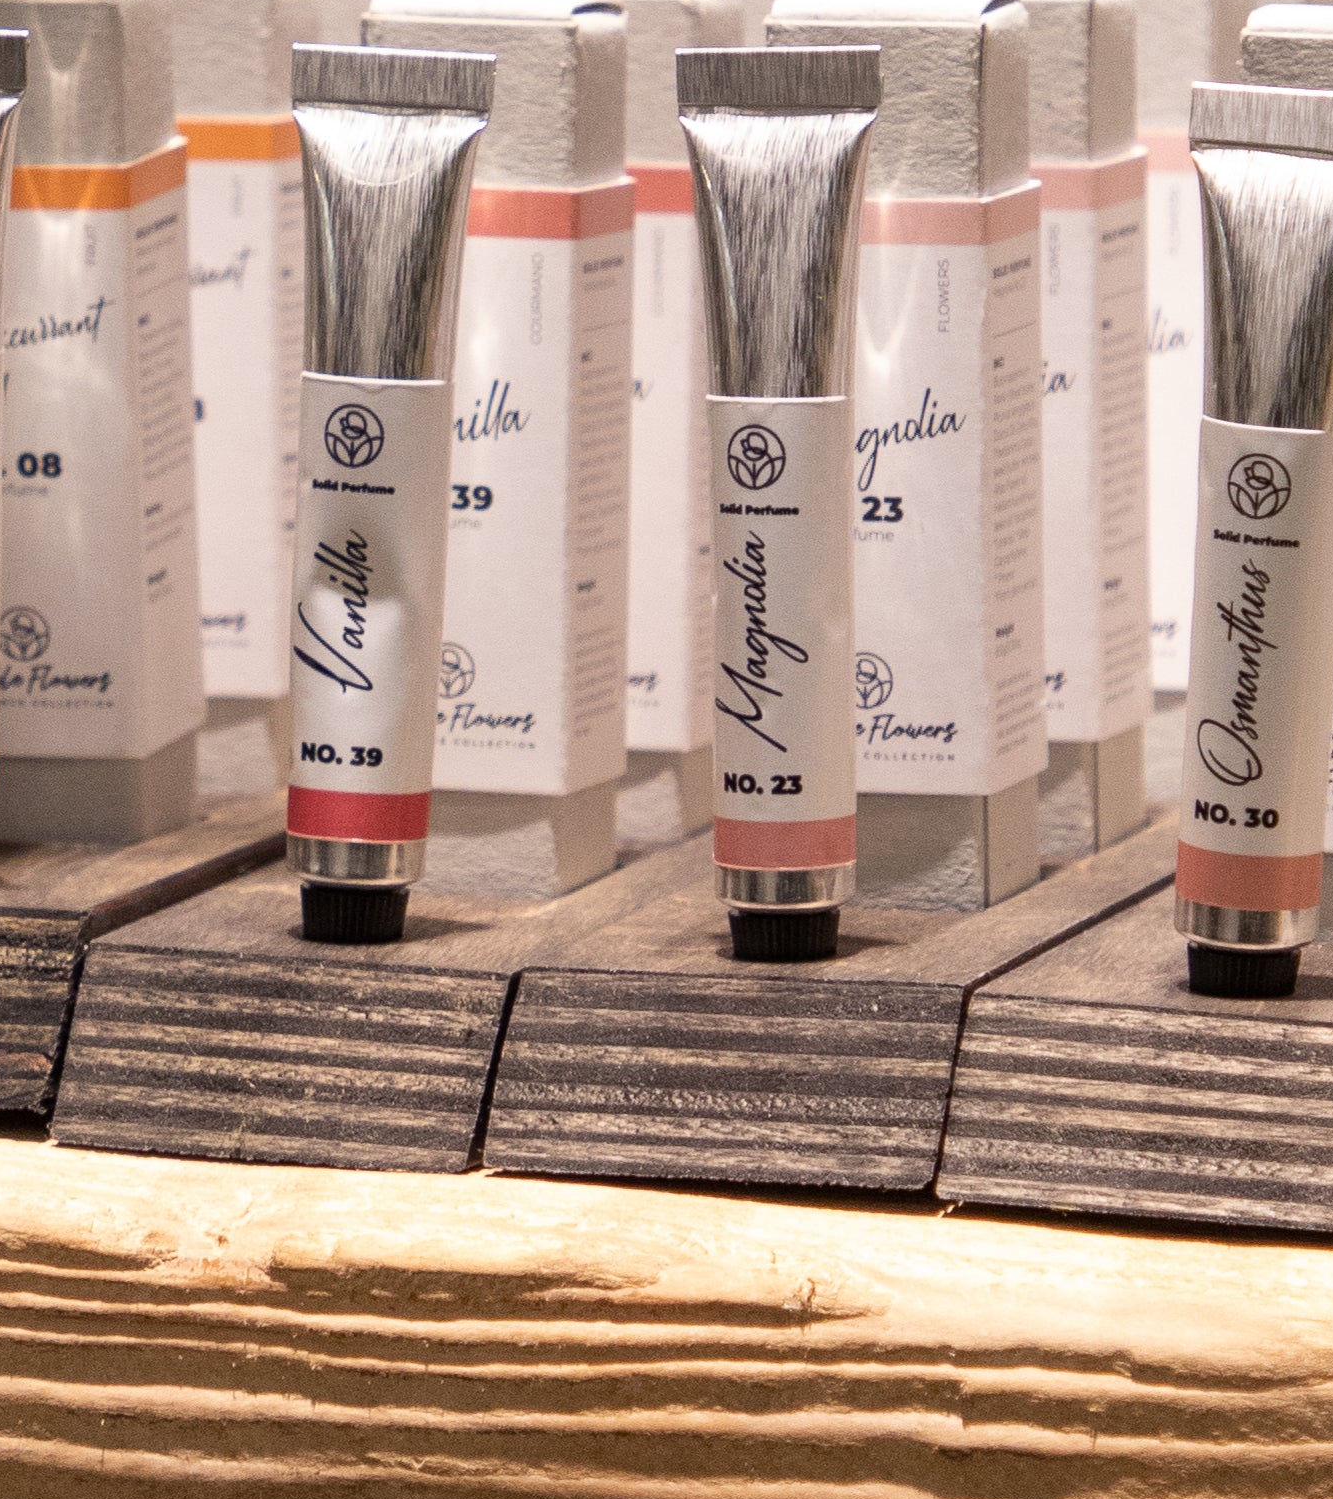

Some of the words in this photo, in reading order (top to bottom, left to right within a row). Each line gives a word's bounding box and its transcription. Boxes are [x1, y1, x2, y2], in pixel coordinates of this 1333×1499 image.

[937, 258, 951, 334] FLOWERS
[3, 296, 117, 350] currant
[855, 386, 967, 491] gnolia
[17, 452, 63, 479] 08
[312, 478, 340, 491] Solid
[341, 481, 396, 495] Perfume
[451, 484, 494, 511] 39
[720, 503, 743, 515] Solid
[745, 504, 800, 516] Perfume
[861, 495, 905, 523] 23
[853, 528, 896, 542] fume
[1213, 528, 1241, 544] Solid
[1243, 534, 1301, 549] Perfume
[293, 528, 374, 694] Vanilla
[714, 529, 809, 754] Magnolia
[26, 664, 113, 697] Flowers
[1197, 557, 1280, 787] Osmanthus
[449, 702, 536, 734] Flowers
[867, 712, 959, 746] Flowers
[300, 742, 343, 766] NO.
[349, 745, 384, 768] 39
[863, 751, 956, 762] COLLECTION
[723, 771, 765, 795] NO.
[770, 774, 803, 796] 23
[1194, 798, 1237, 827] NO.
[1243, 806, 1280, 830] 30
